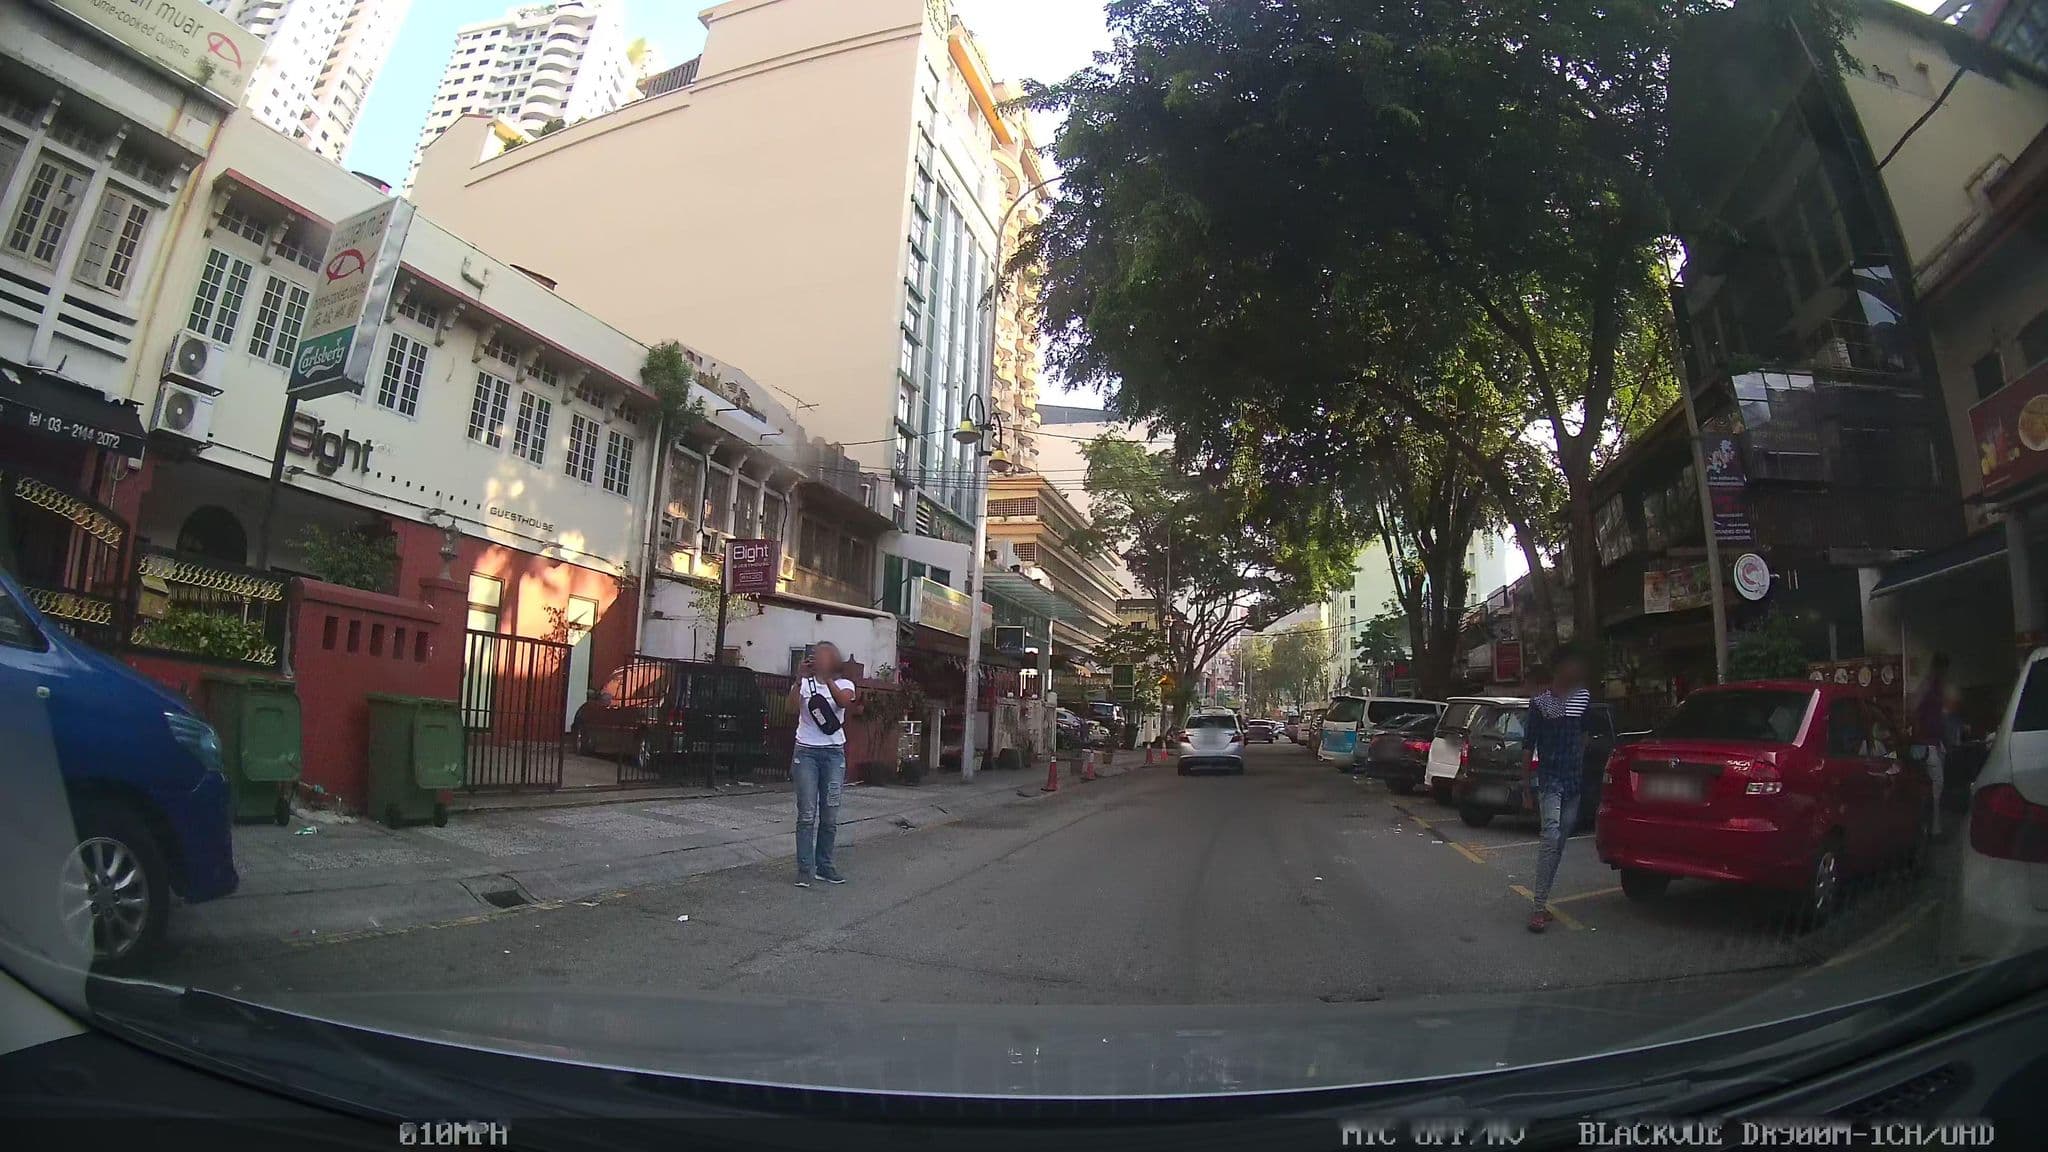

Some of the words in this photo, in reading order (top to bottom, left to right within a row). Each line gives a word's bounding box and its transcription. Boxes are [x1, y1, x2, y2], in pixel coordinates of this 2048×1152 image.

[86, 0, 156, 37] ome-cooked
[155, 32, 191, 59] cuisine
[154, 1, 204, 39] muar
[298, 344, 345, 374] Carlsberg
[47, 416, 62, 433] 03
[71, 423, 95, 441] 2144
[96, 431, 121, 449] 2072
[489, 506, 554, 533] GUESTHOUSE
